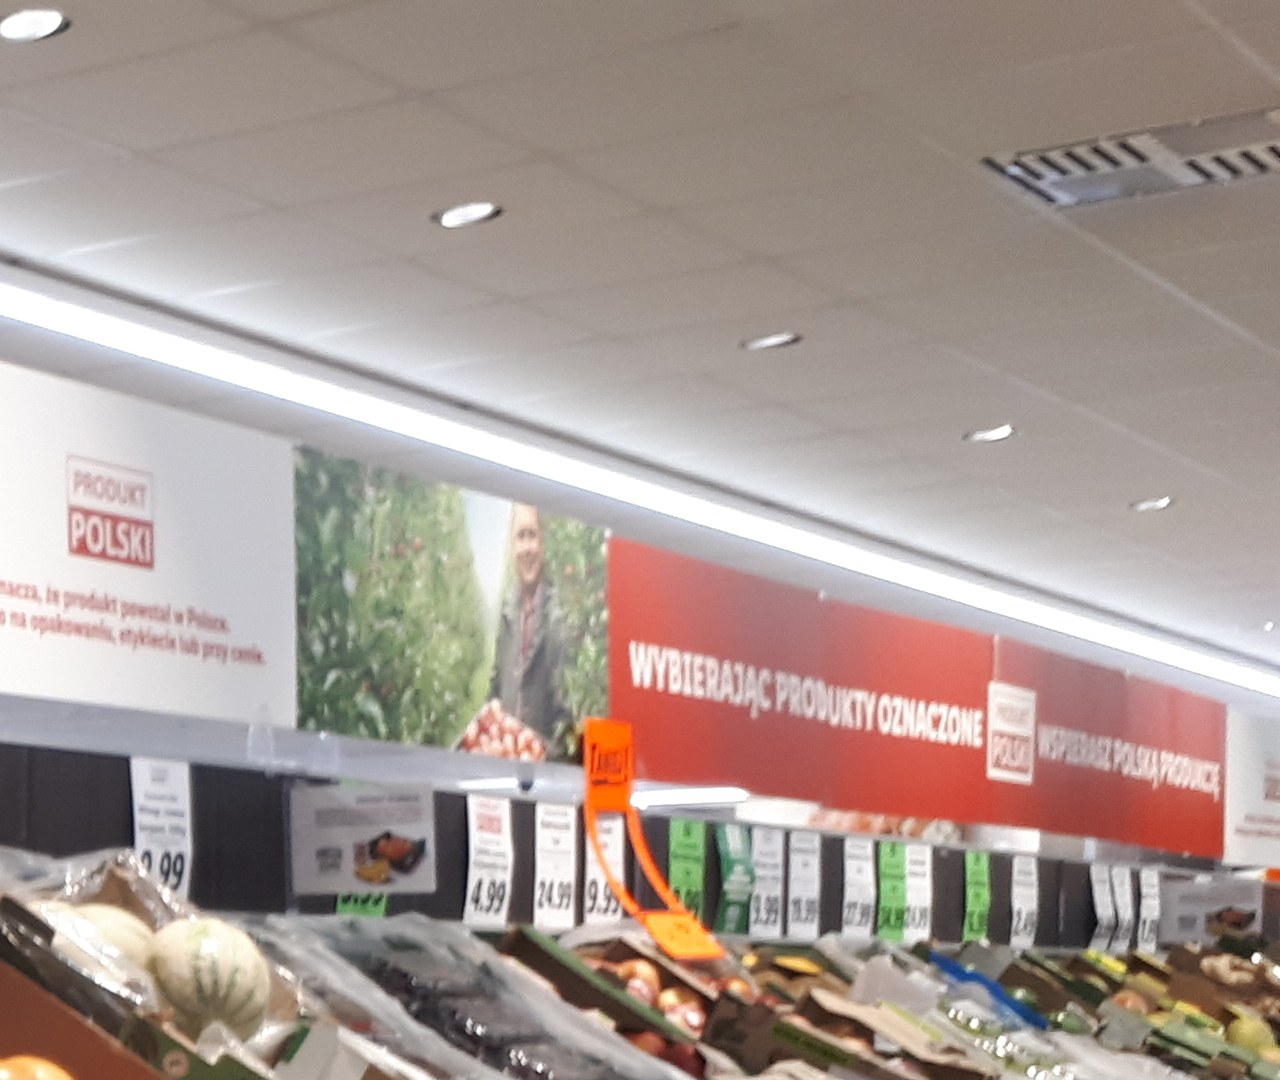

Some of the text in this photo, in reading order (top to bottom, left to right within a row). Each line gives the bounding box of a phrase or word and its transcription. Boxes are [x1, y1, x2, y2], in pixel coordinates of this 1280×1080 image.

[72, 470, 148, 508] PRODUKT
[70, 513, 151, 564] POLSKI
[629, 640, 984, 749] WYBIERAJĄC PRODUKTY OZNACZONE
[141, 850, 185, 890] 99
[471, 876, 507, 914] 4.99
